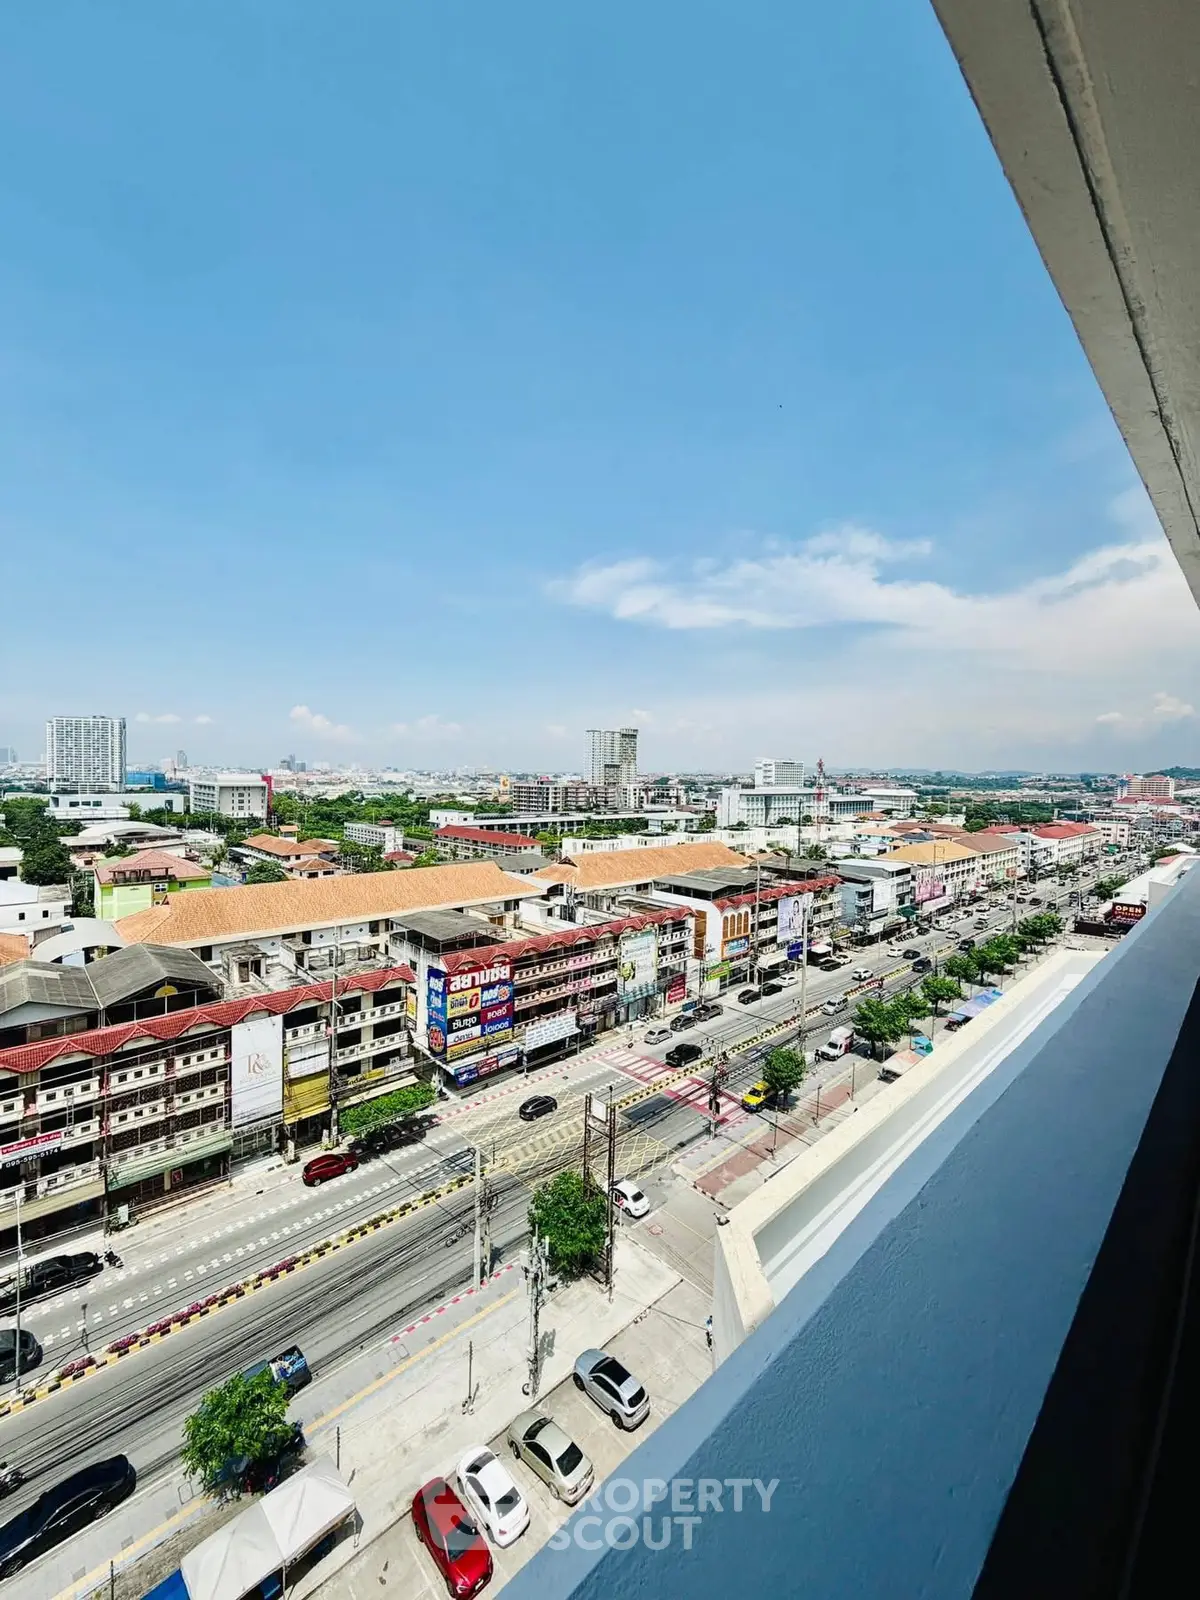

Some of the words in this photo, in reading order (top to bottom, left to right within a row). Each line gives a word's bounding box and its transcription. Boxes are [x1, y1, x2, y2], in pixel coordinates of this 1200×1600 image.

[1115, 905, 1142, 913] OPEN
[450, 963, 511, 992] สยามชัย
